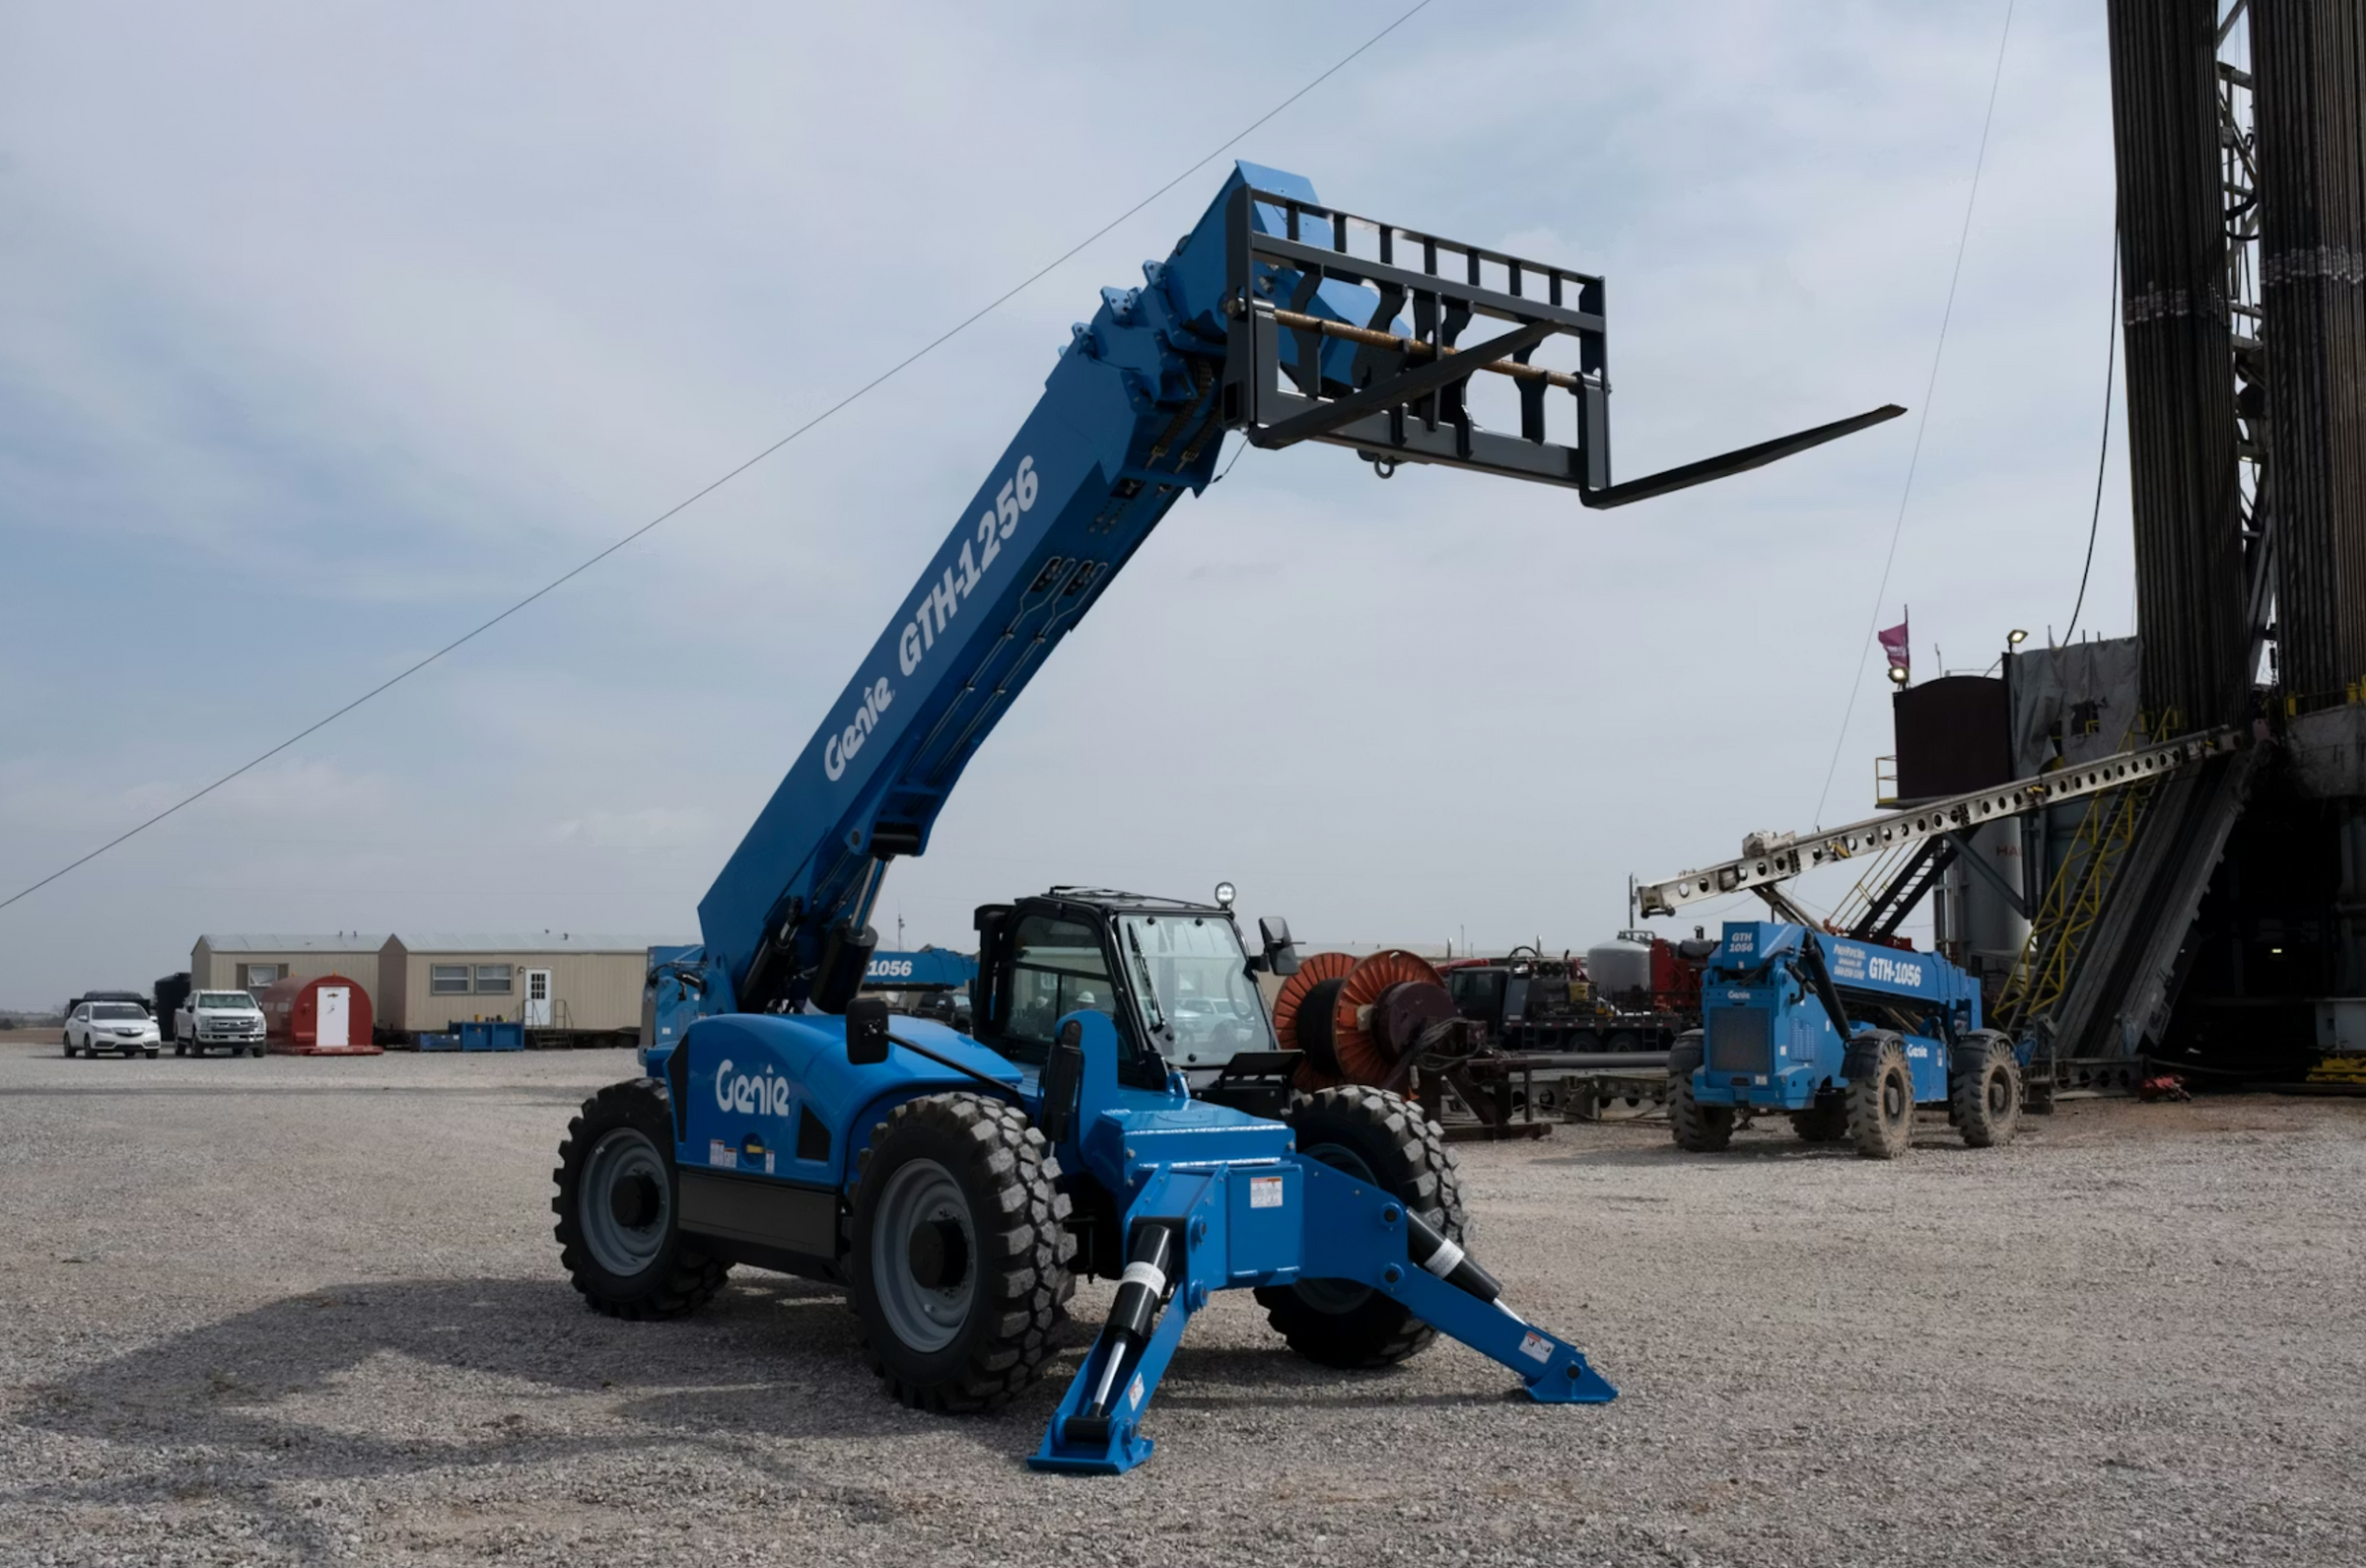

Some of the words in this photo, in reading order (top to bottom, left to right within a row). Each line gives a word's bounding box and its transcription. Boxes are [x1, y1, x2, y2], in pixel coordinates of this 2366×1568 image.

[824, 676, 891, 782] Genie
[899, 454, 1039, 677] GTH-1256
[1731, 932, 1753, 942] GTH
[1728, 943, 1754, 953] 1056
[1869, 956, 1922, 988] GTH-1056
[1727, 989, 1751, 999] Genie
[1907, 1044, 1928, 1058] Genie
[715, 1058, 790, 1117] Genie
